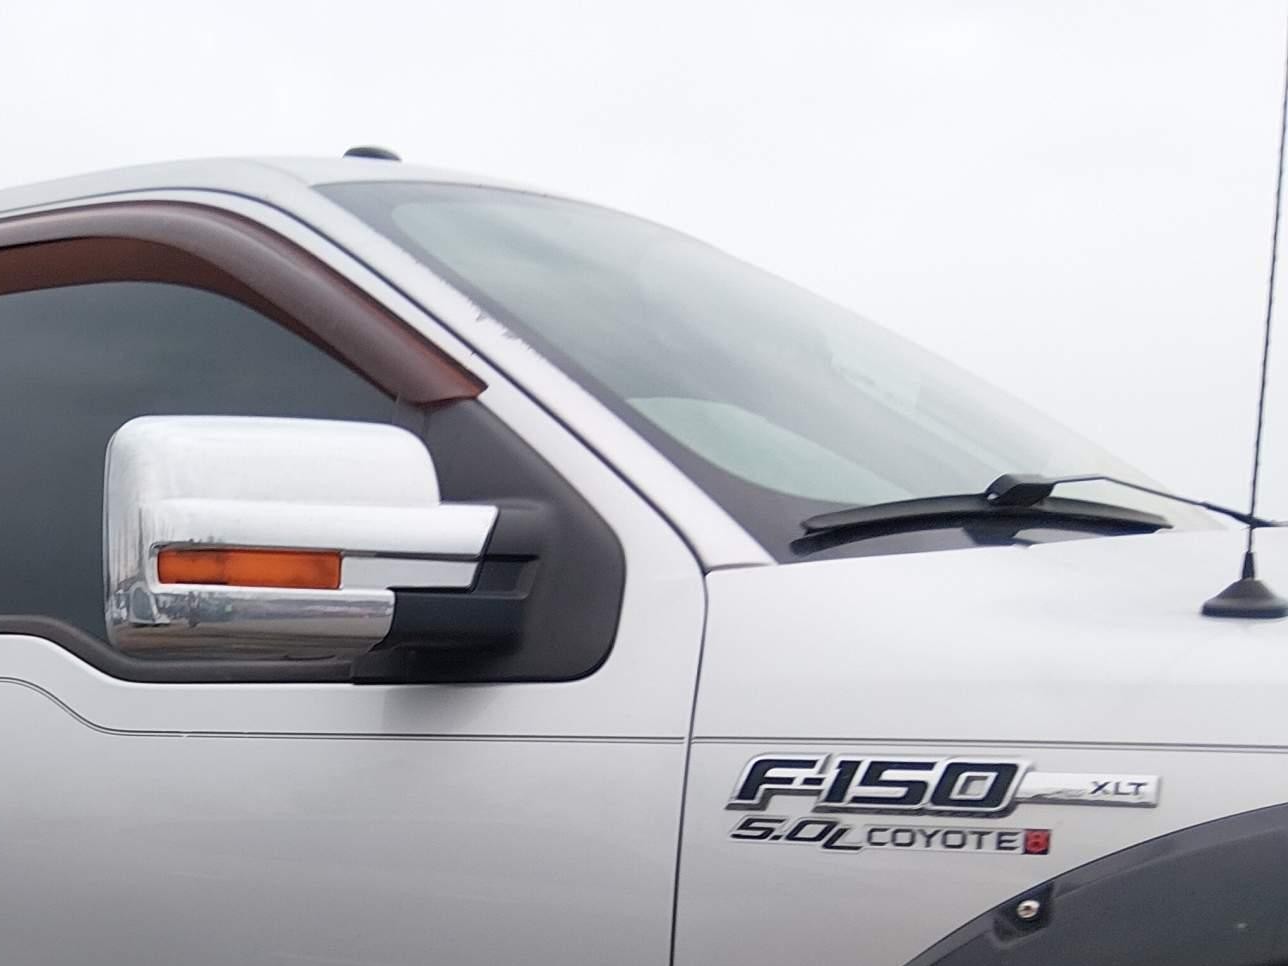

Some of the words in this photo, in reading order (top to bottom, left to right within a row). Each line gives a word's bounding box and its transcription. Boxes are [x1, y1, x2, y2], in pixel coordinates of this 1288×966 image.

[727, 753, 1024, 813] F-150
[1090, 780, 1149, 797] XLT
[729, 816, 864, 851] 5.0L
[866, 827, 1021, 851] COYOTE
